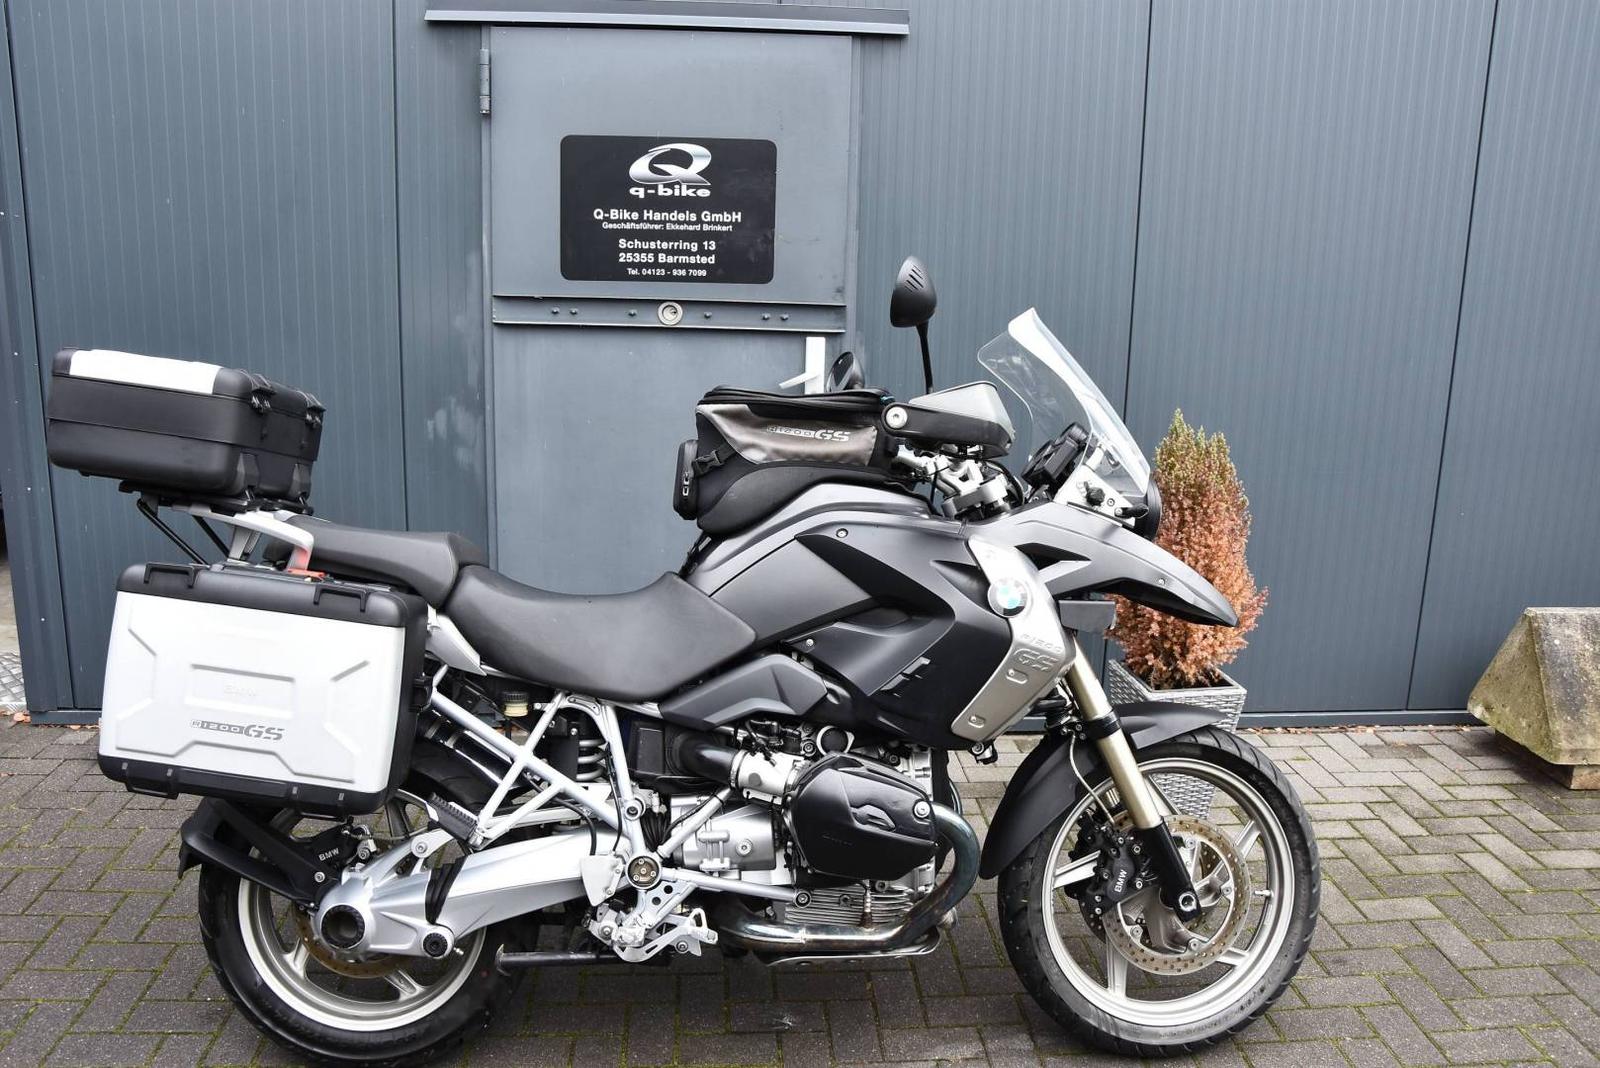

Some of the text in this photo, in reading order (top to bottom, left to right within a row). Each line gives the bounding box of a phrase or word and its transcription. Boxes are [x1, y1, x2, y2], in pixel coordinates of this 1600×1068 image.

[629, 185, 711, 198] q-bike
[593, 208, 742, 222] Q-Bike Handels GmbH
[602, 221, 733, 231] Geschäftsführer: Ekkehard Brinkert
[618, 238, 716, 252] Schusterring 13
[618, 252, 715, 264] 25355 Barmsted
[641, 268, 666, 276] 04123
[318, 847, 339, 861] BMW
[1114, 869, 1127, 893] BMW
